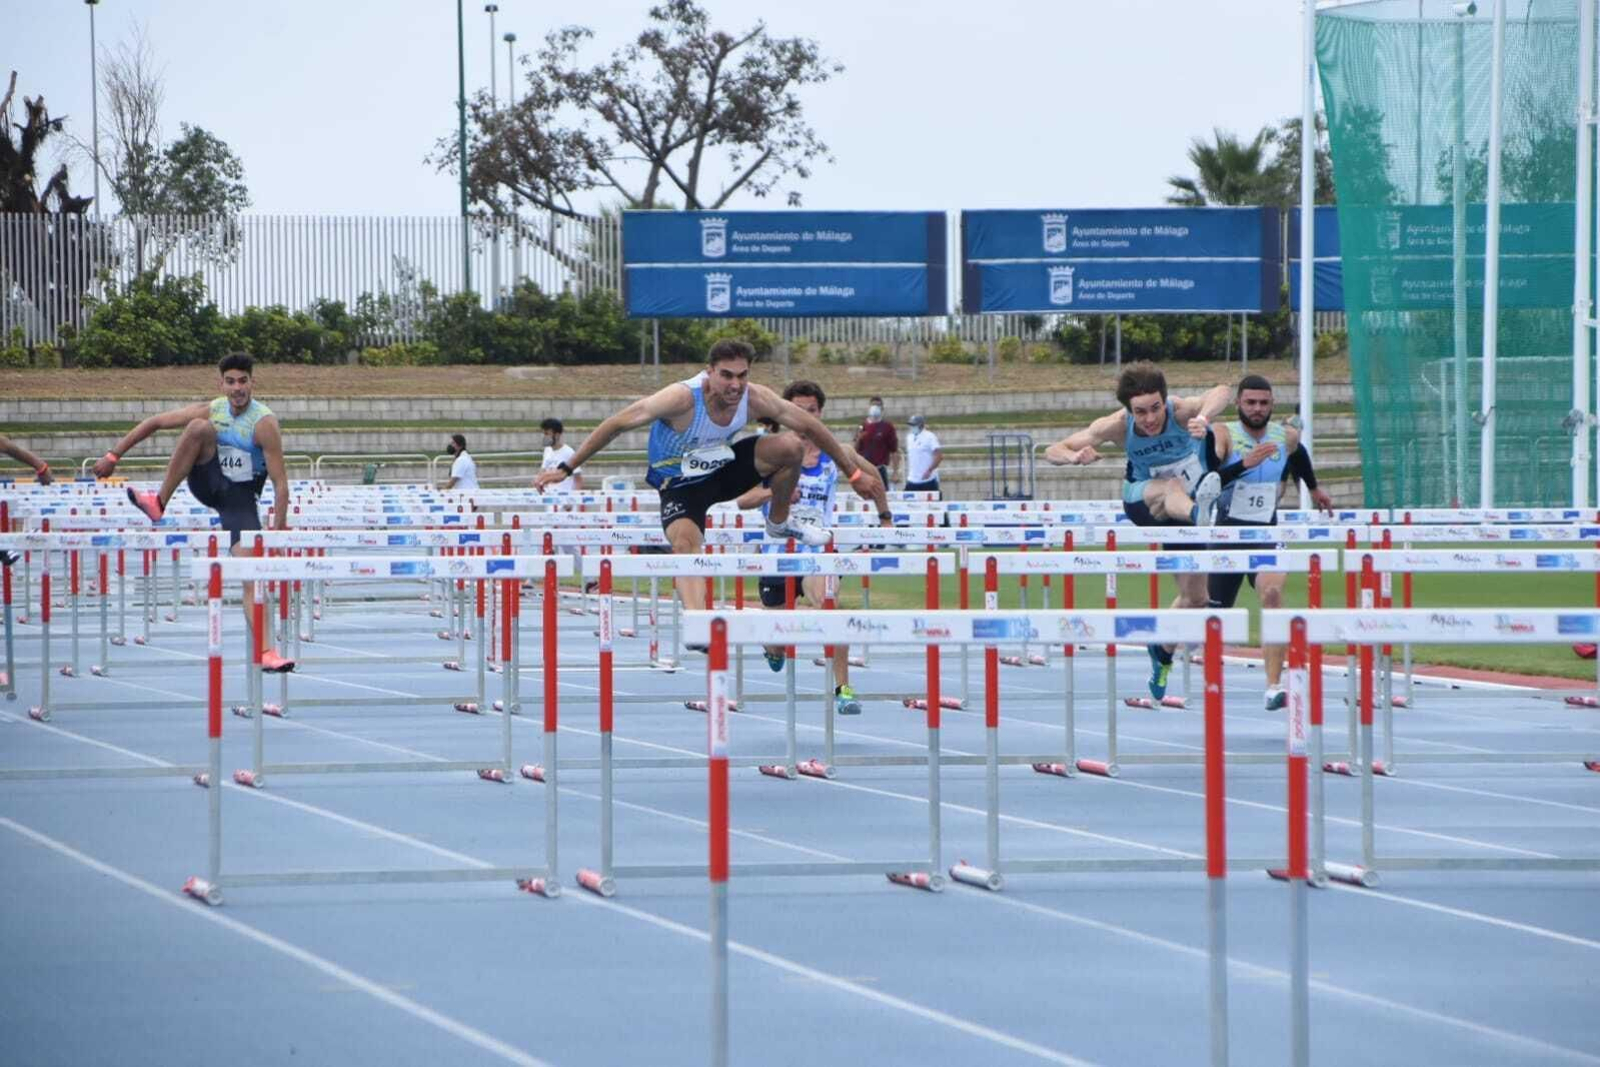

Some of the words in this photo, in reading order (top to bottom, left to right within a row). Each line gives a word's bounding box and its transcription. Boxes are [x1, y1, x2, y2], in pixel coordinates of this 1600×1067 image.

[732, 230, 800, 242] Ayuntamiento
[802, 231, 814, 240] de
[816, 230, 853, 242] Málaga
[1072, 226, 1138, 237] Ayuntamiento
[1140, 226, 1152, 235] de
[1154, 225, 1189, 237] Málaga
[732, 243, 749, 252] Área
[762, 244, 791, 253] Deporte
[1072, 239, 1089, 247] Área
[1101, 240, 1129, 248] Deporte
[1079, 278, 1144, 290] Ayuntamiento
[1146, 279, 1157, 288] de
[1160, 278, 1195, 289] Málaga
[736, 286, 803, 297] Ayuntamiento
[804, 286, 817, 295] de
[819, 285, 855, 298] Málaga
[1078, 291, 1095, 299] Área
[1107, 292, 1135, 300] Deporte
[736, 299, 753, 307] Área
[766, 300, 795, 308] Deporte
[1249, 496, 1264, 508] 16
